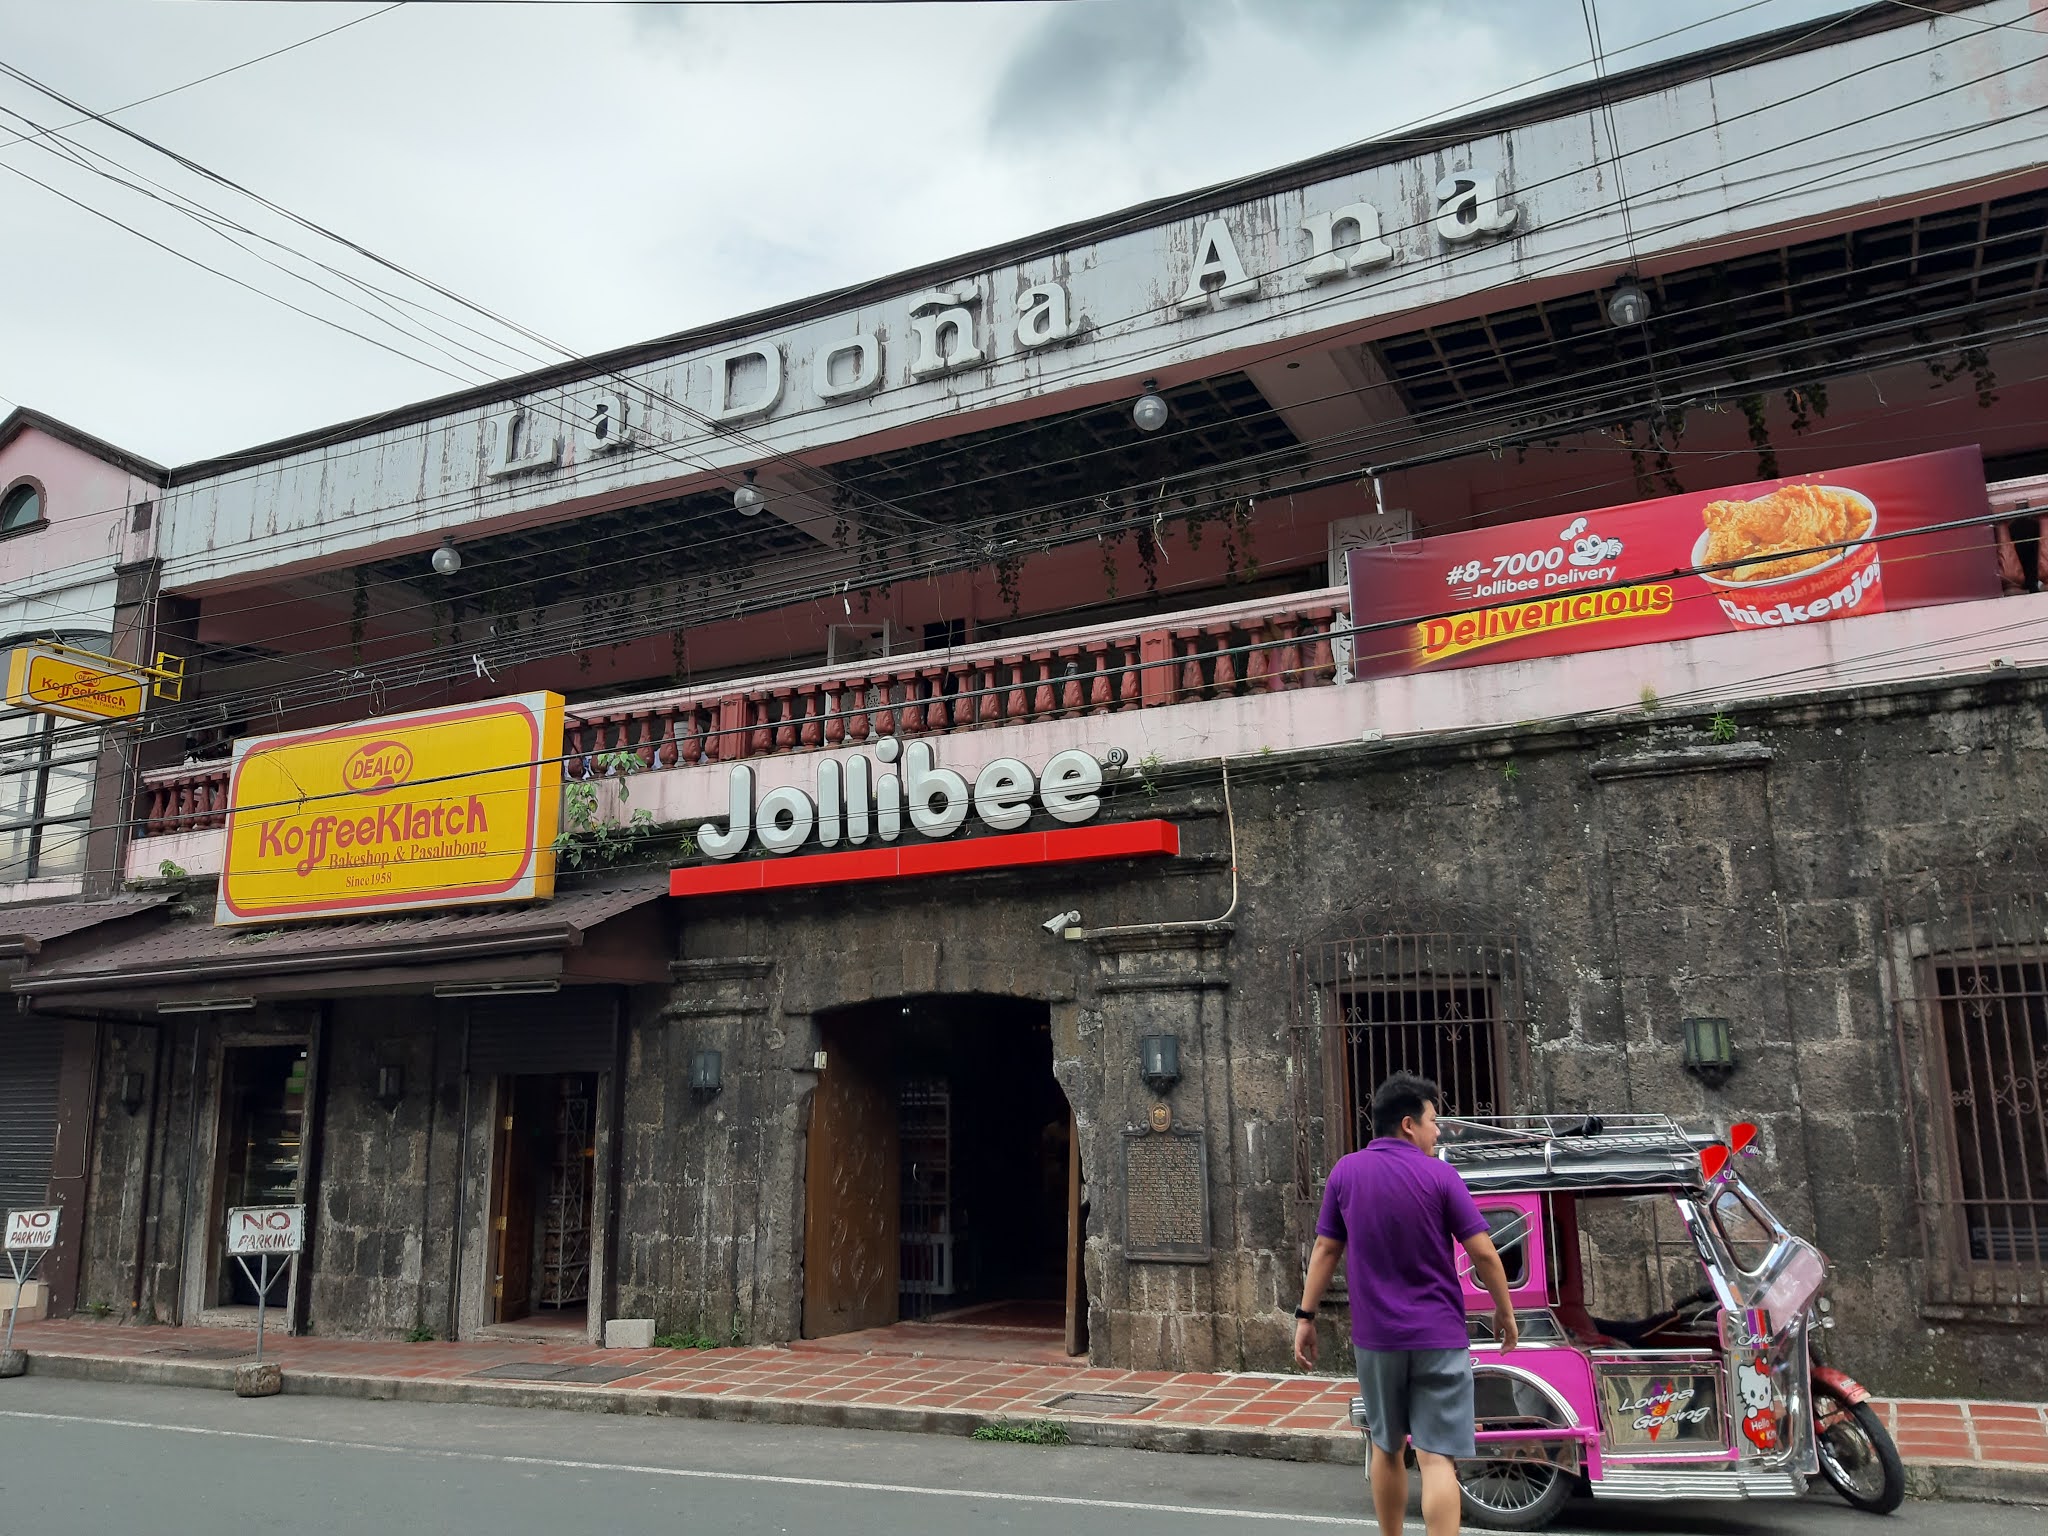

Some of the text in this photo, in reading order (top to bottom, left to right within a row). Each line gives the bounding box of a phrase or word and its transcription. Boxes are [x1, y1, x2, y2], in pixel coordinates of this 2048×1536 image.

[487, 168, 1519, 478] La Doña Ana
[1446, 546, 1564, 586] #8-7000
[1472, 565, 1617, 599] Jollibee Delivery
[1718, 551, 1881, 626] Chickenjoy
[1426, 585, 1672, 655] Delivericious
[352, 753, 405, 780] DEALO
[697, 736, 1103, 860] Jollibee
[258, 795, 488, 877] KoffeeKlatch
[329, 840, 487, 870] Bakeshop & Pasalubong
[346, 872, 392, 888] Since 1958
[17, 1212, 50, 1229] NO
[242, 1211, 291, 1231] NO
[10, 1230, 51, 1244] PARKING
[238, 1231, 296, 1249] PARKING
[1618, 1388, 1695, 1412] Lorina
[1633, 1406, 1711, 1430] Goring
[1751, 1418, 1770, 1433] Hello
